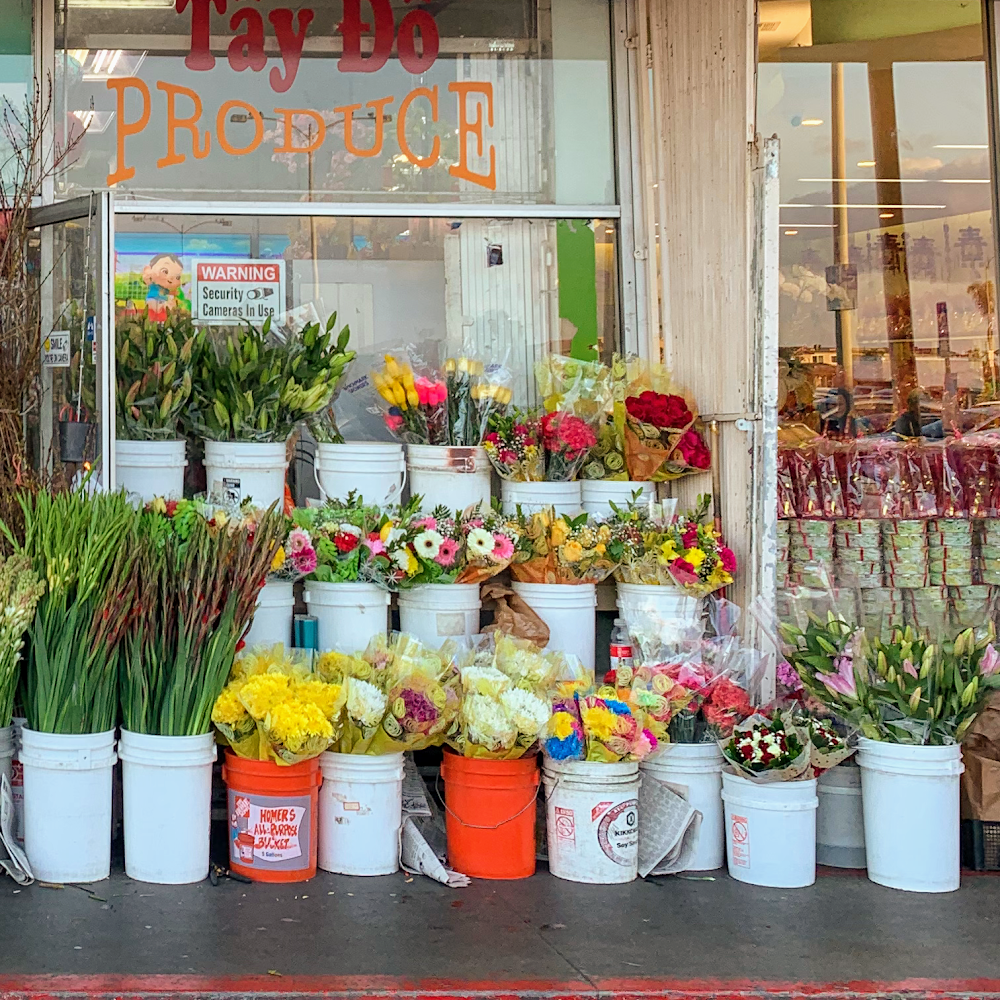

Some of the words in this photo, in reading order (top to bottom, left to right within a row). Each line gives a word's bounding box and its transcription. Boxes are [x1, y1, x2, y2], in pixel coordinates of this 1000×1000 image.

[106, 77, 497, 190] PRODUCE
[201, 265, 275, 281] WARNING
[202, 286, 244, 303] Security
[202, 303, 243, 317] Cameras
[246, 305, 255, 317] In
[258, 305, 275, 317] Use
